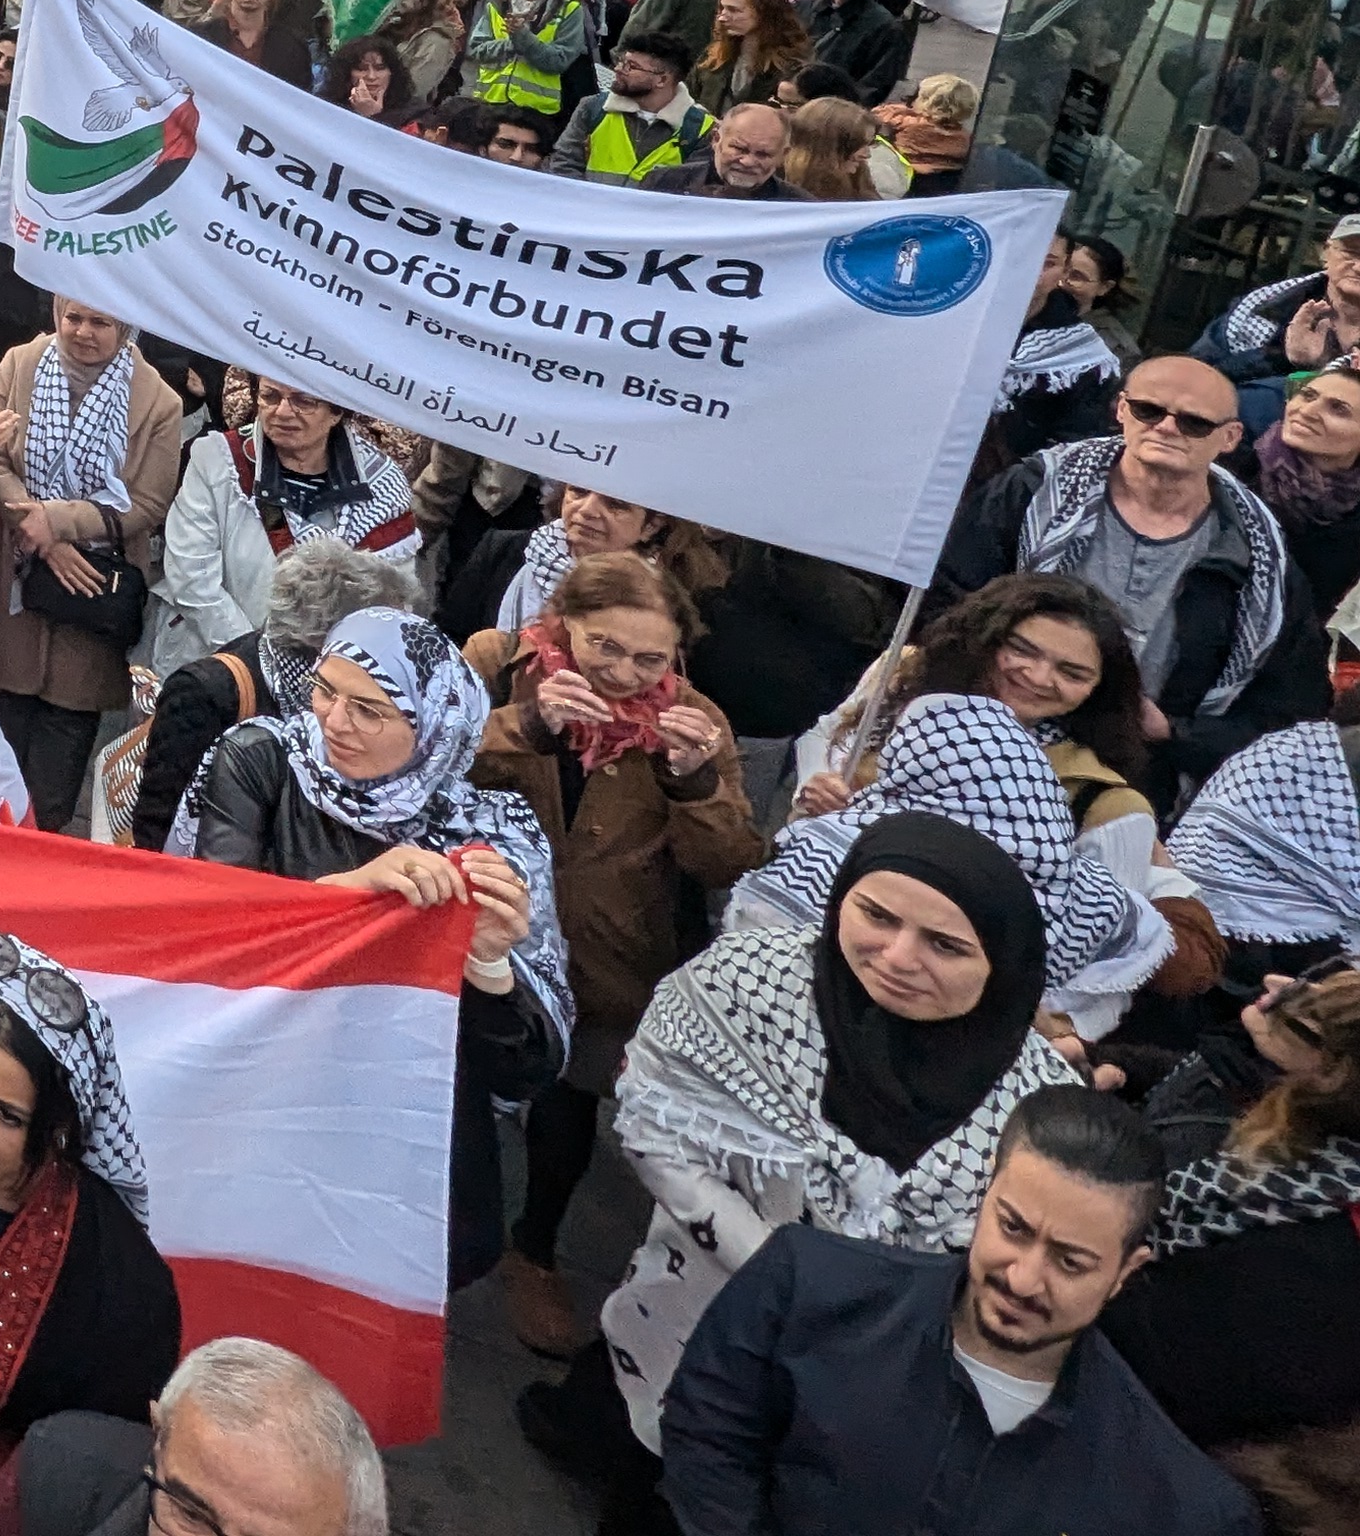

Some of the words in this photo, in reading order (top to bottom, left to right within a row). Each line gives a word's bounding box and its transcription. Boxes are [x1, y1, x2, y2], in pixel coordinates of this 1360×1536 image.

[43, 209, 178, 258] PALESTINE
[219, 172, 749, 369] Kvinnoförbundet
[236, 124, 765, 300] Palestinska
[203, 220, 364, 308] Stockholm
[405, 308, 606, 390] Föreningen
[622, 374, 731, 420] Bisan
[524, 424, 618, 468] اتحاد
